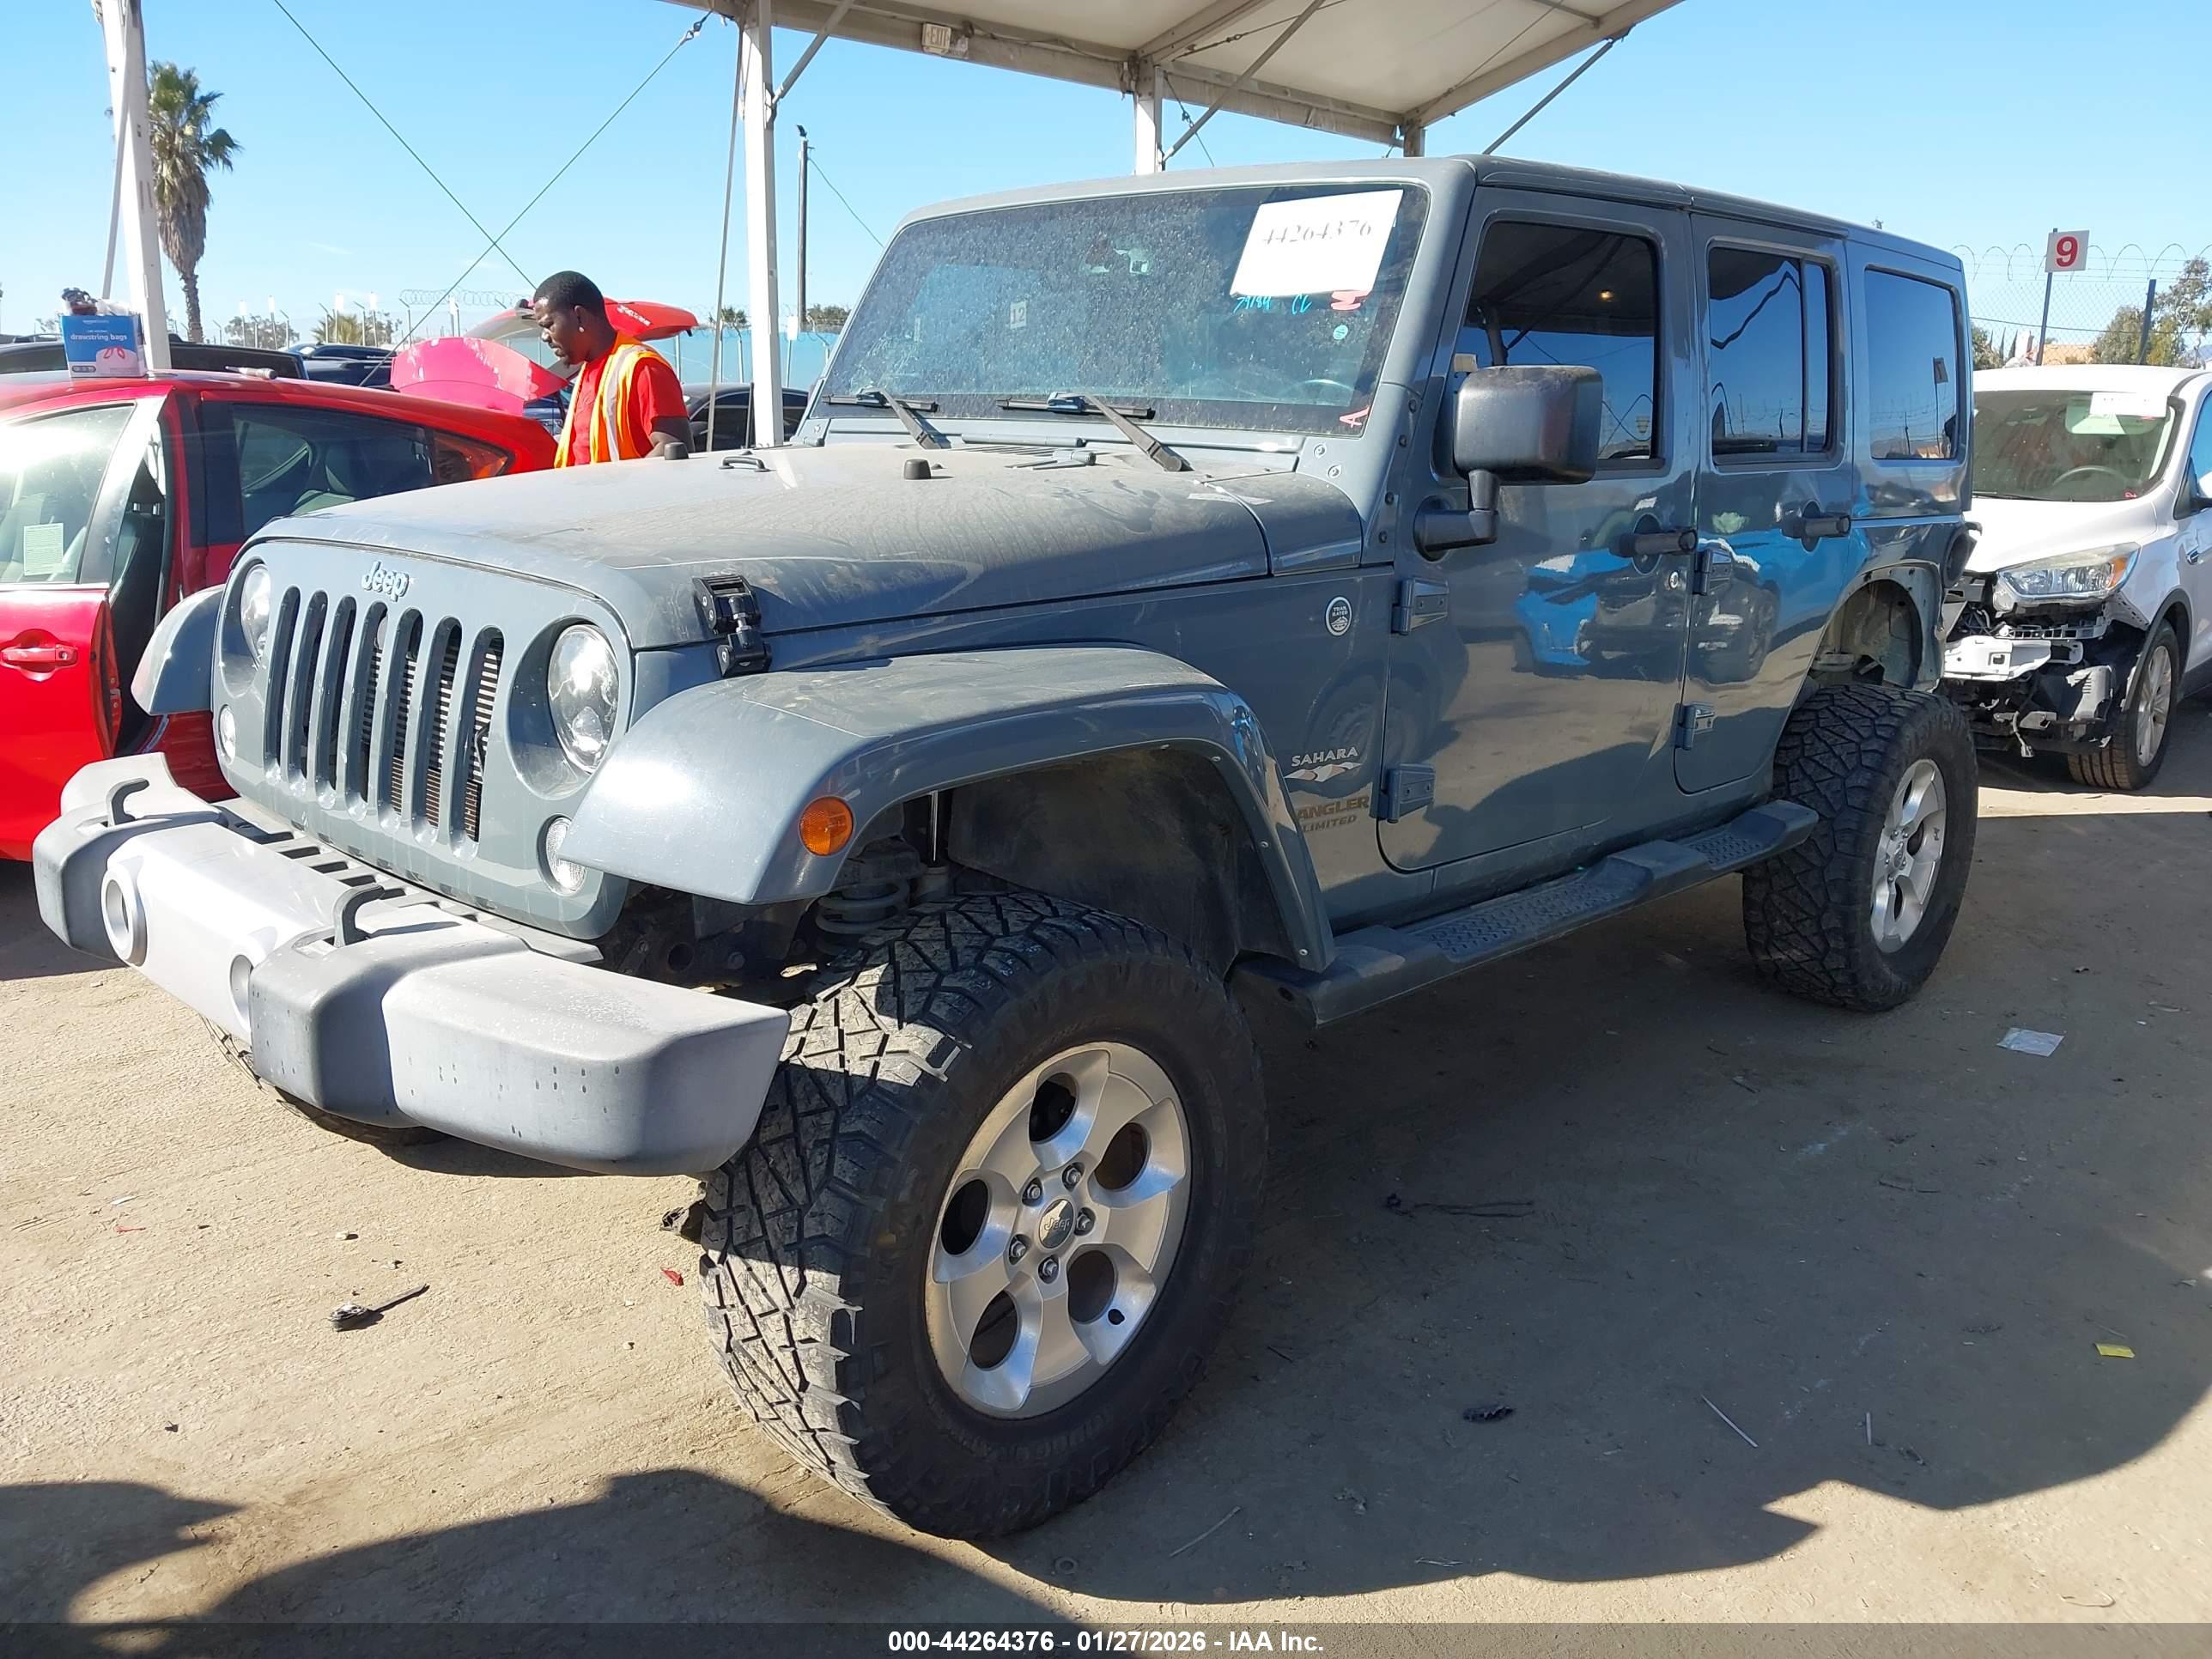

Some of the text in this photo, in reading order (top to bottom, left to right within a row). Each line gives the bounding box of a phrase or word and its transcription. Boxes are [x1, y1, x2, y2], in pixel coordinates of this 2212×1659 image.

[2056, 236, 2078, 267] 9
[361, 560, 410, 603] Jeep
[1291, 746, 1358, 767] SAHARA
[1297, 796, 1370, 818] ANGLER
[1303, 814, 1358, 833] LIMITED
[1044, 1217, 1071, 1231] Jeep
